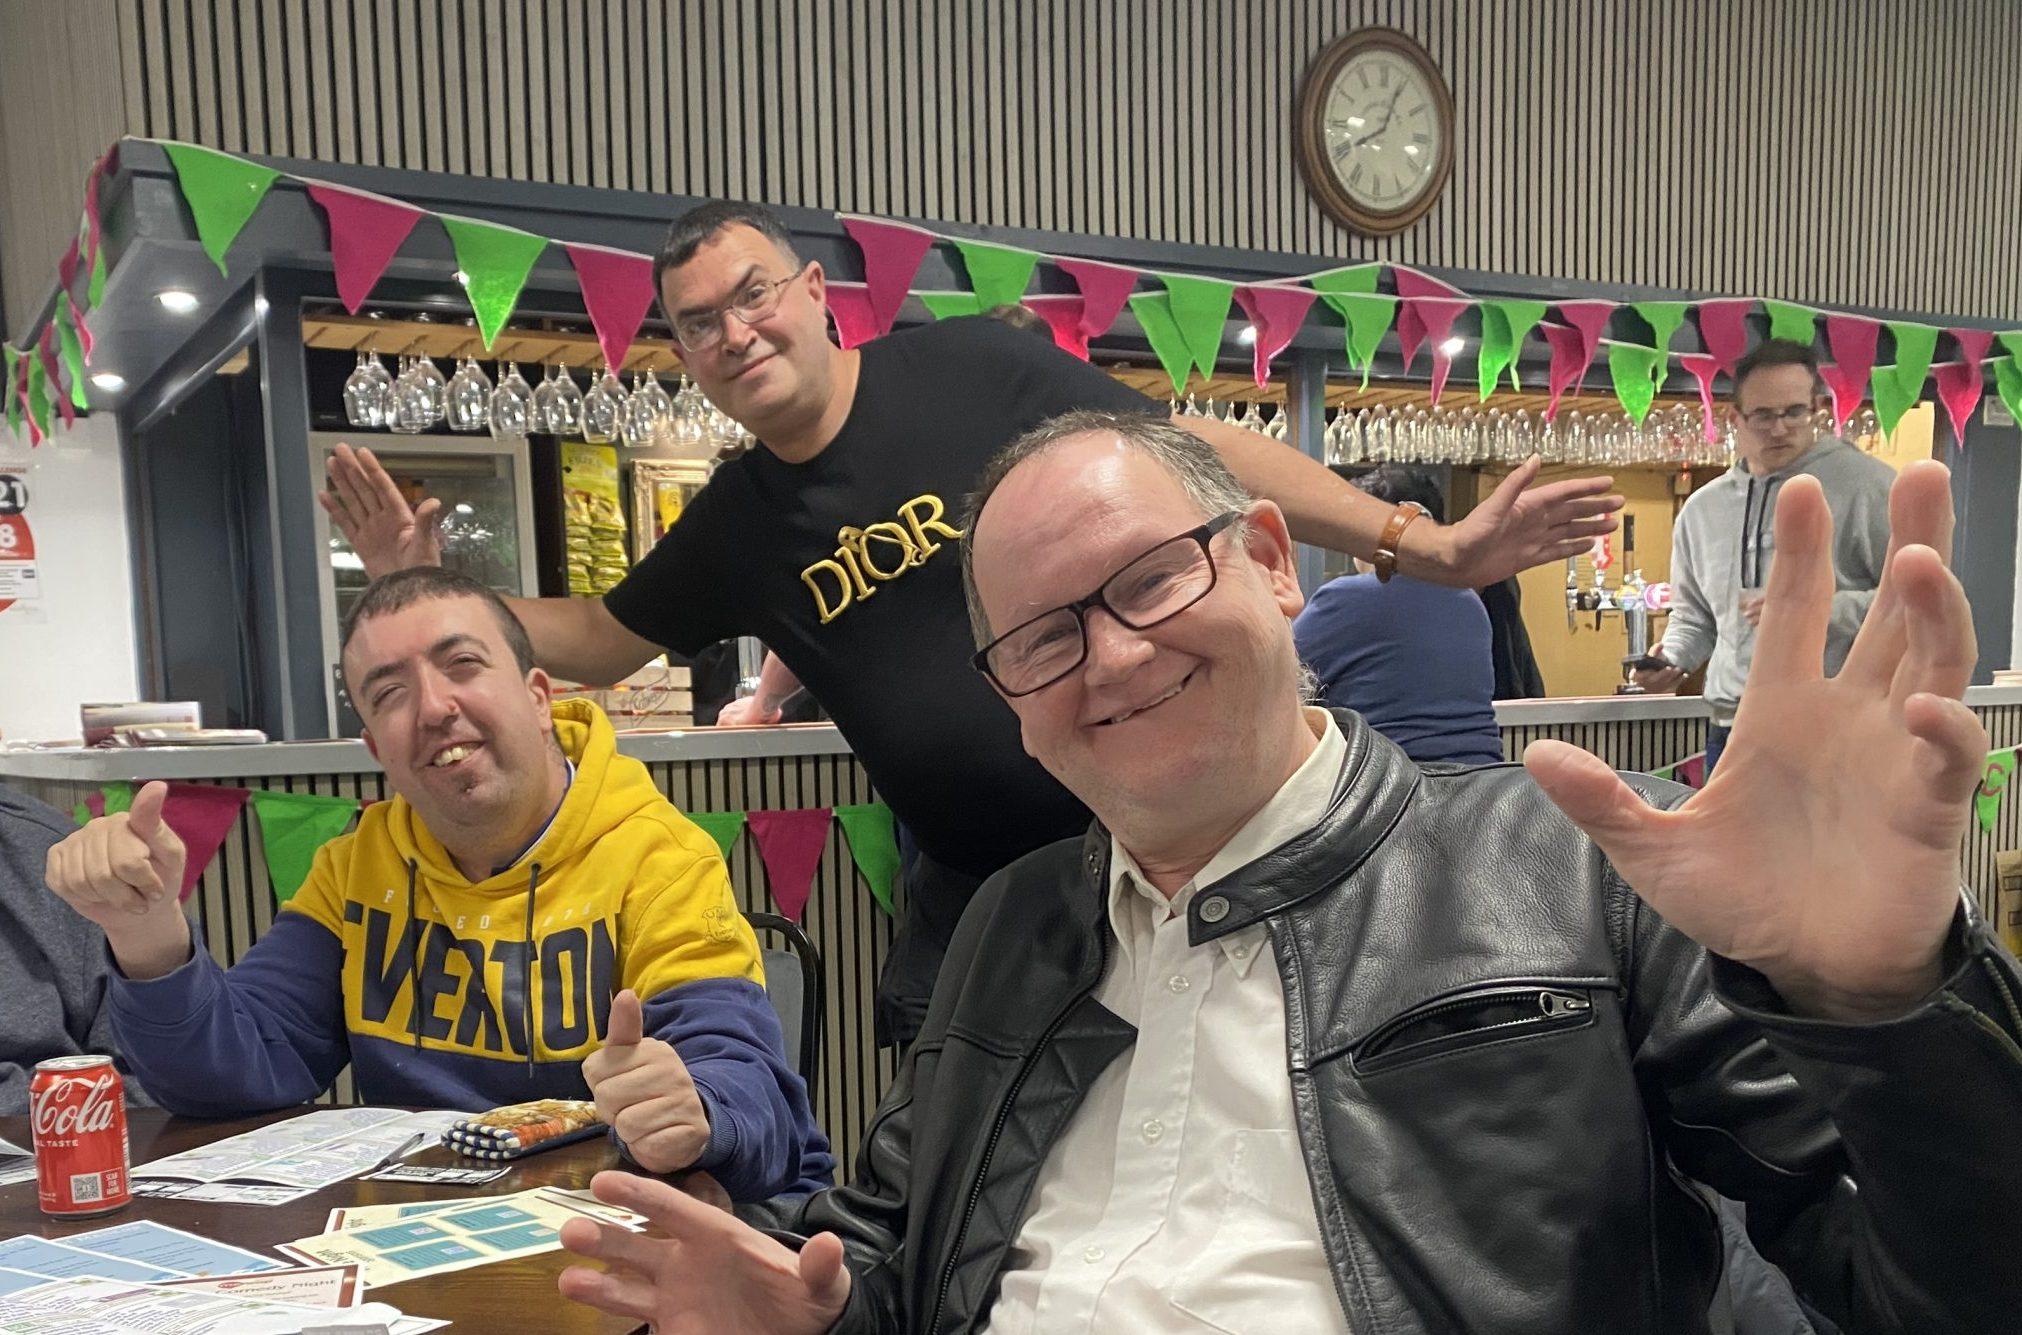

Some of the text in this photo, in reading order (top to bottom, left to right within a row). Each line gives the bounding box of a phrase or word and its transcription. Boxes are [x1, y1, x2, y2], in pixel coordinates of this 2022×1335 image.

[801, 494, 965, 624] DIOR
[344, 901, 620, 1056] VERTON
[46, 1138, 79, 1148] TASTE
